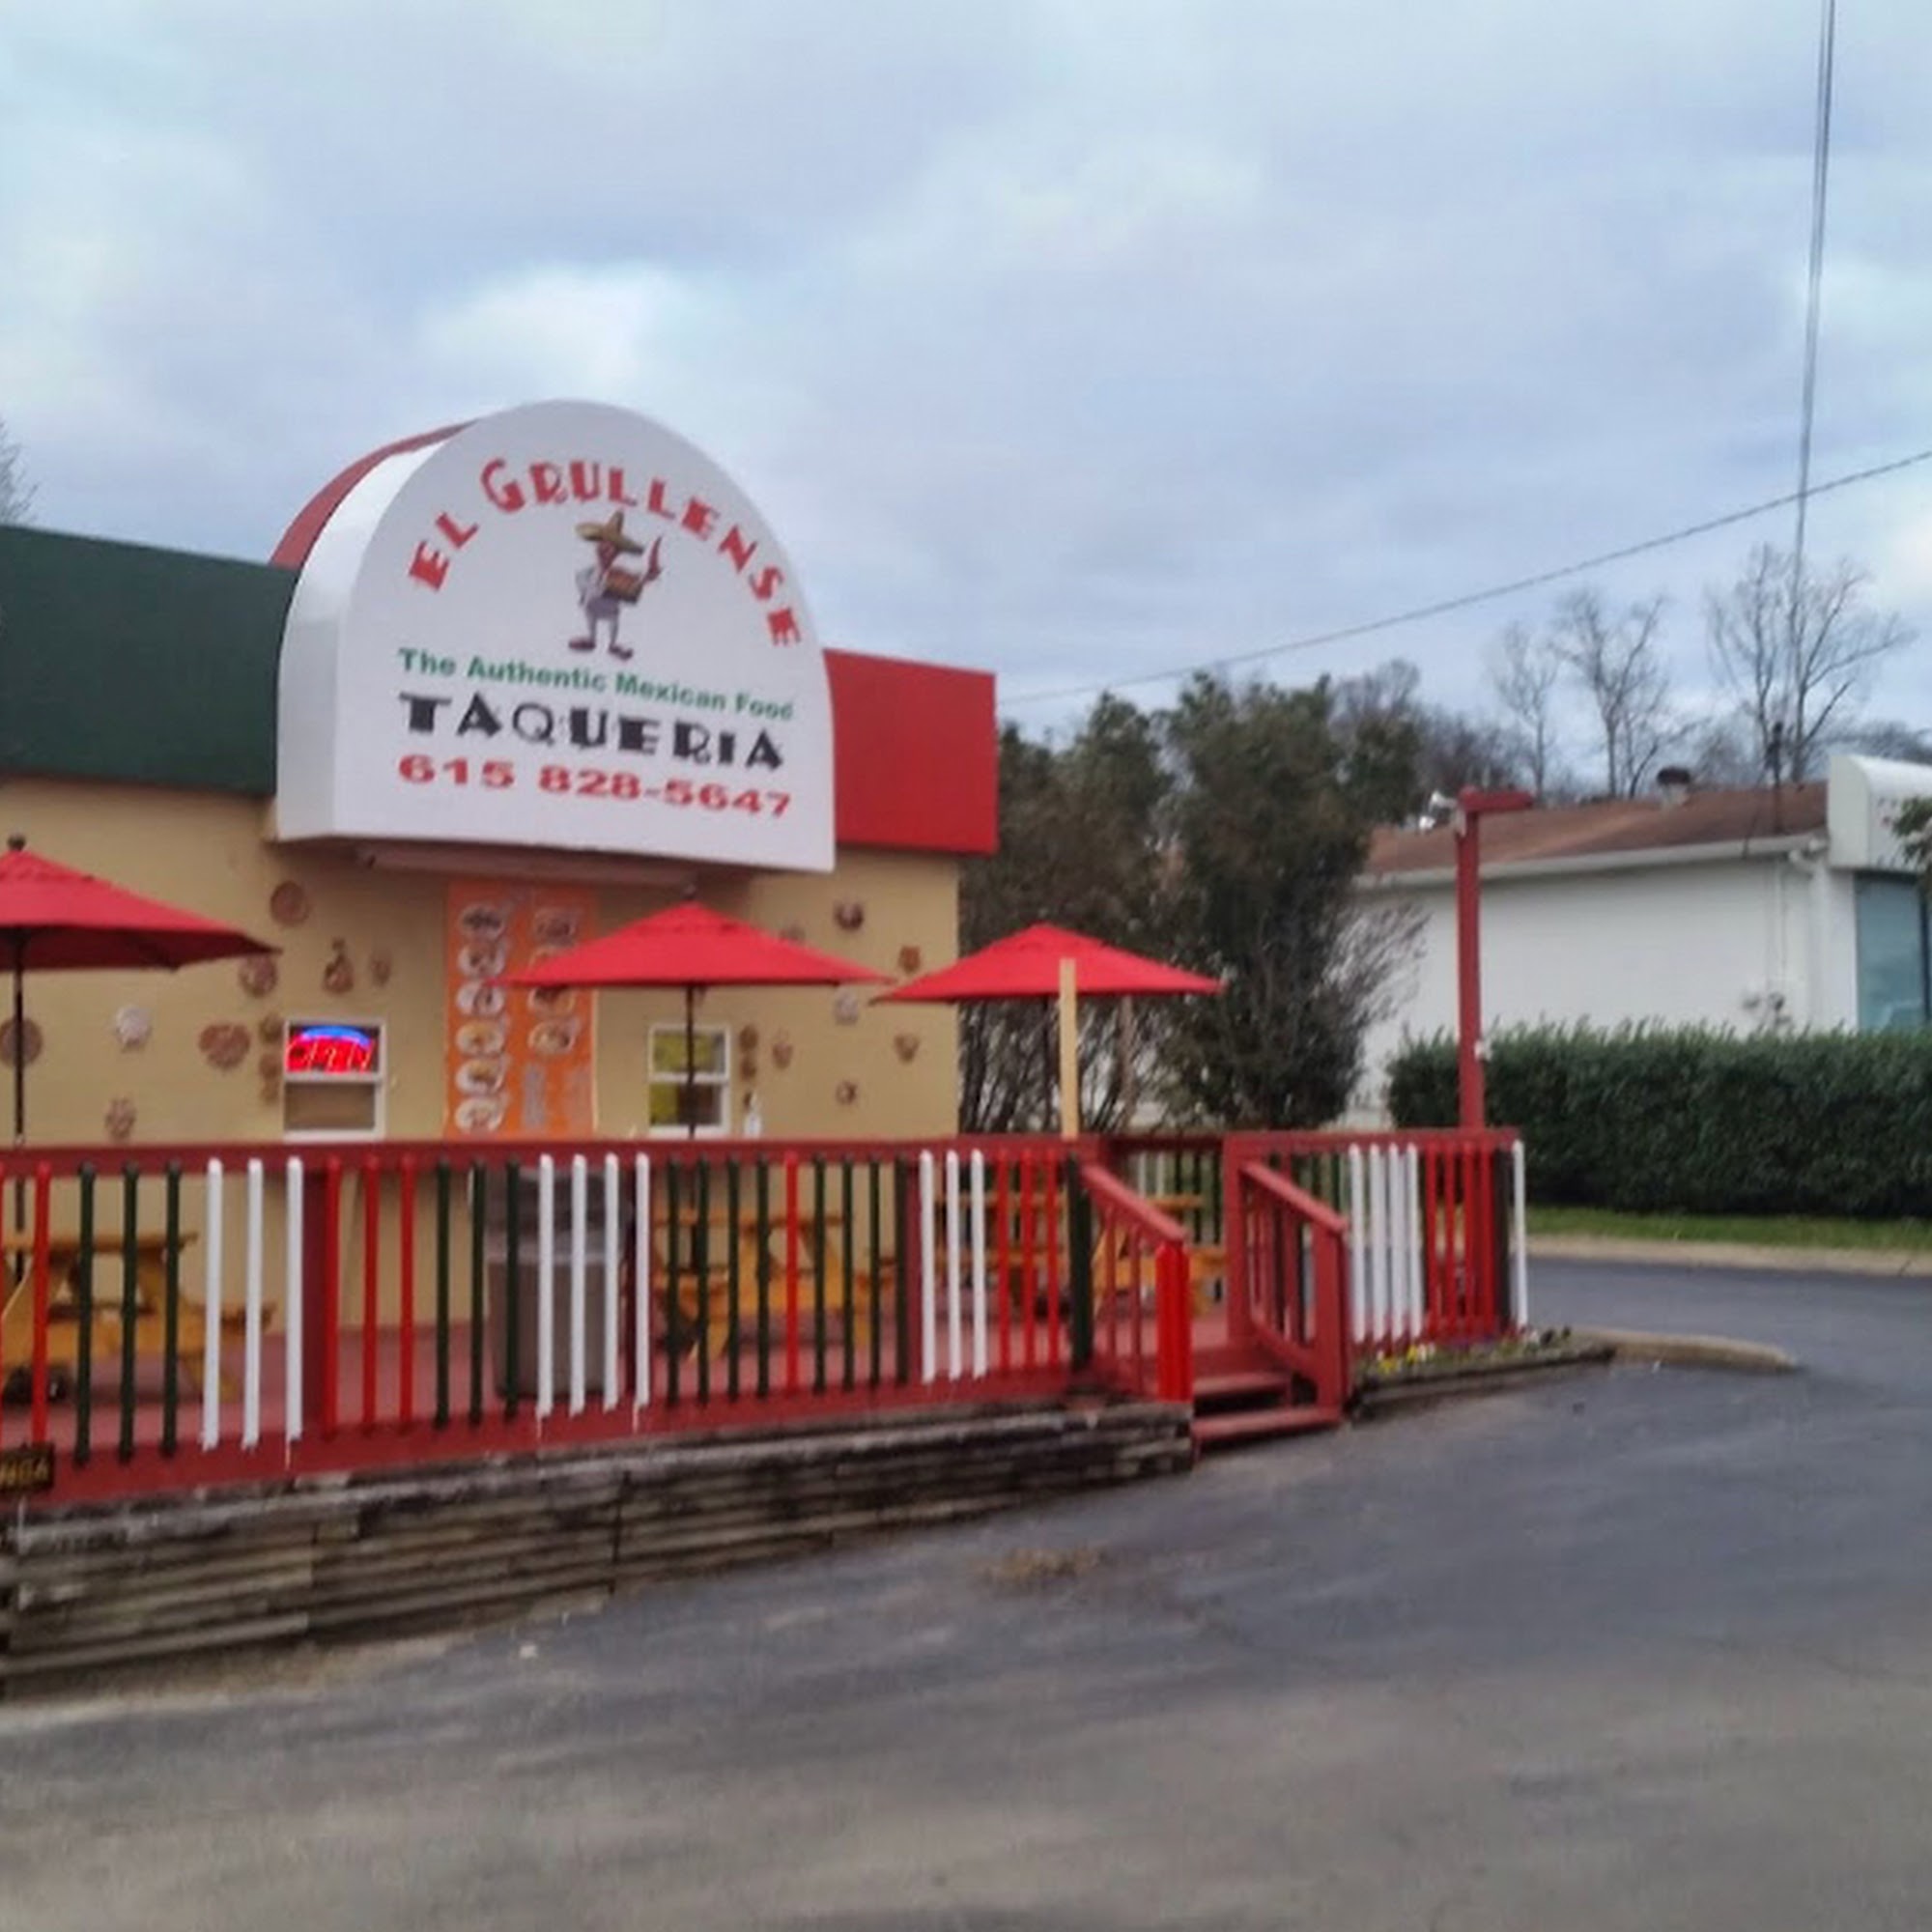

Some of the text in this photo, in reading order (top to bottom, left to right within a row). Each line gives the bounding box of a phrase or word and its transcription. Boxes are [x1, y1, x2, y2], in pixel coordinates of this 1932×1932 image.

[408, 459, 802, 645] EL GRULLENSE
[399, 648, 794, 722] The Authentic Mexican Food
[399, 692, 783, 771] TAQUERIA
[398, 753, 791, 817] 615 828-5647
